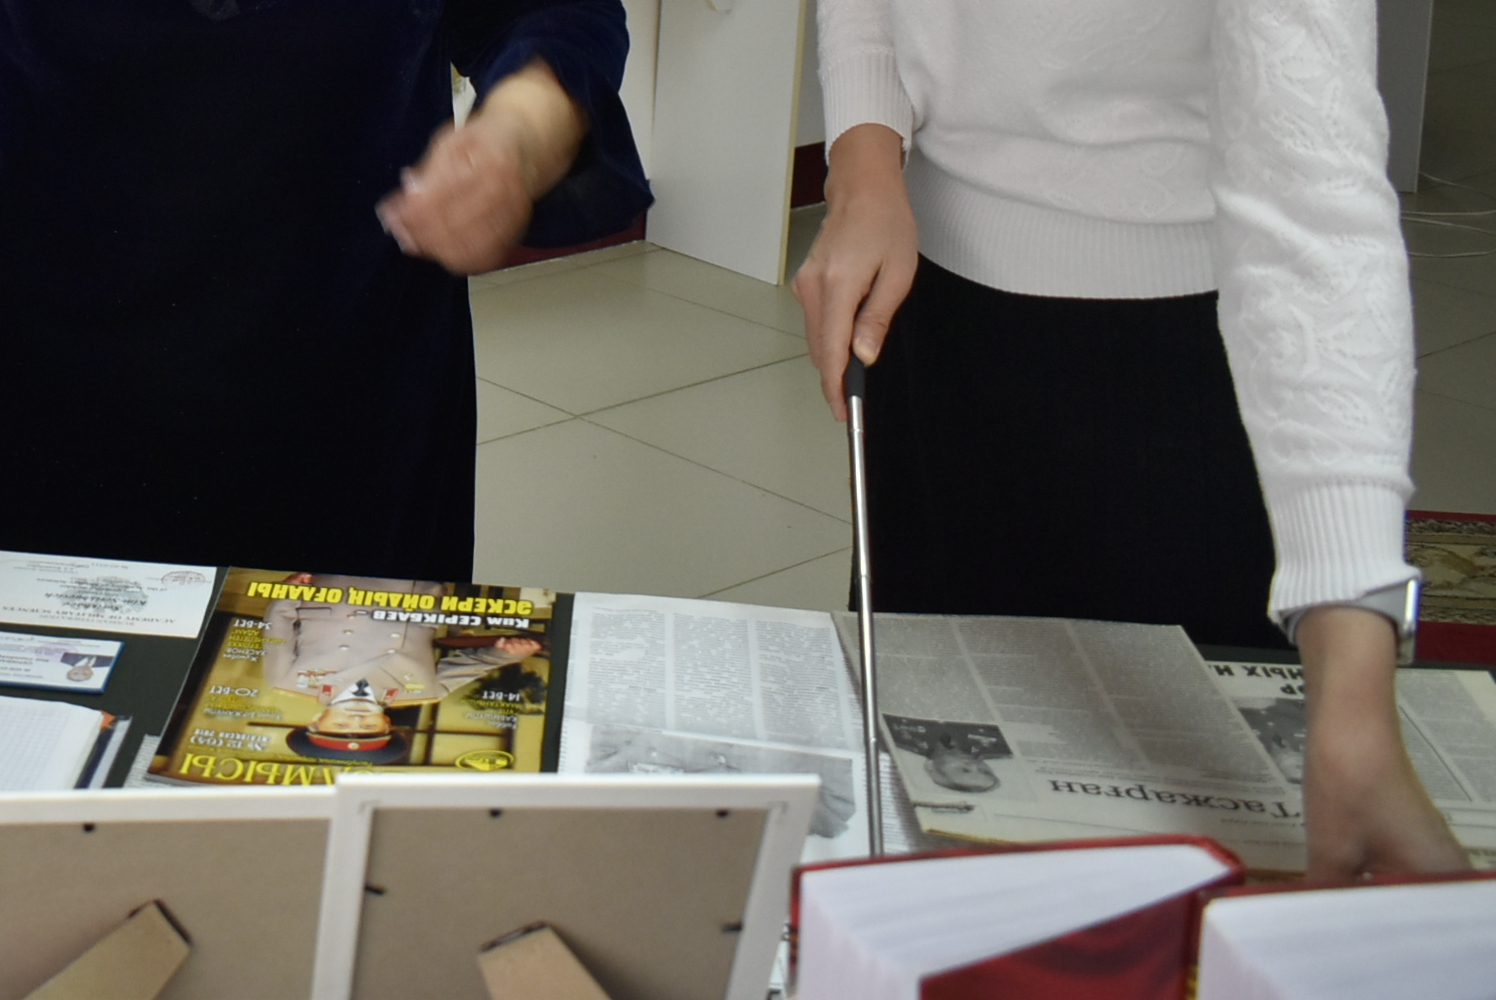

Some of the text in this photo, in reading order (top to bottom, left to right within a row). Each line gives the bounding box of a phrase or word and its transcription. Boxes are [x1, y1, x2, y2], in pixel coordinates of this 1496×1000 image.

[247, 582, 533, 616] ӘСКЕРИ ОЙДЫҢ ОҒЛАНЫ
[2, 606, 52, 614] SCIENCES
[56, 610, 105, 619] MILITARY
[372, 610, 482, 626] СЕРІКБАЕВ
[486, 616, 530, 628] Ким
[233, 619, 273, 630] 34-БЕТ
[209, 685, 259, 697] 20-БЕТ
[482, 691, 520, 702] 14-БЕТ
[1048, 779, 1301, 820] Тасжарған
